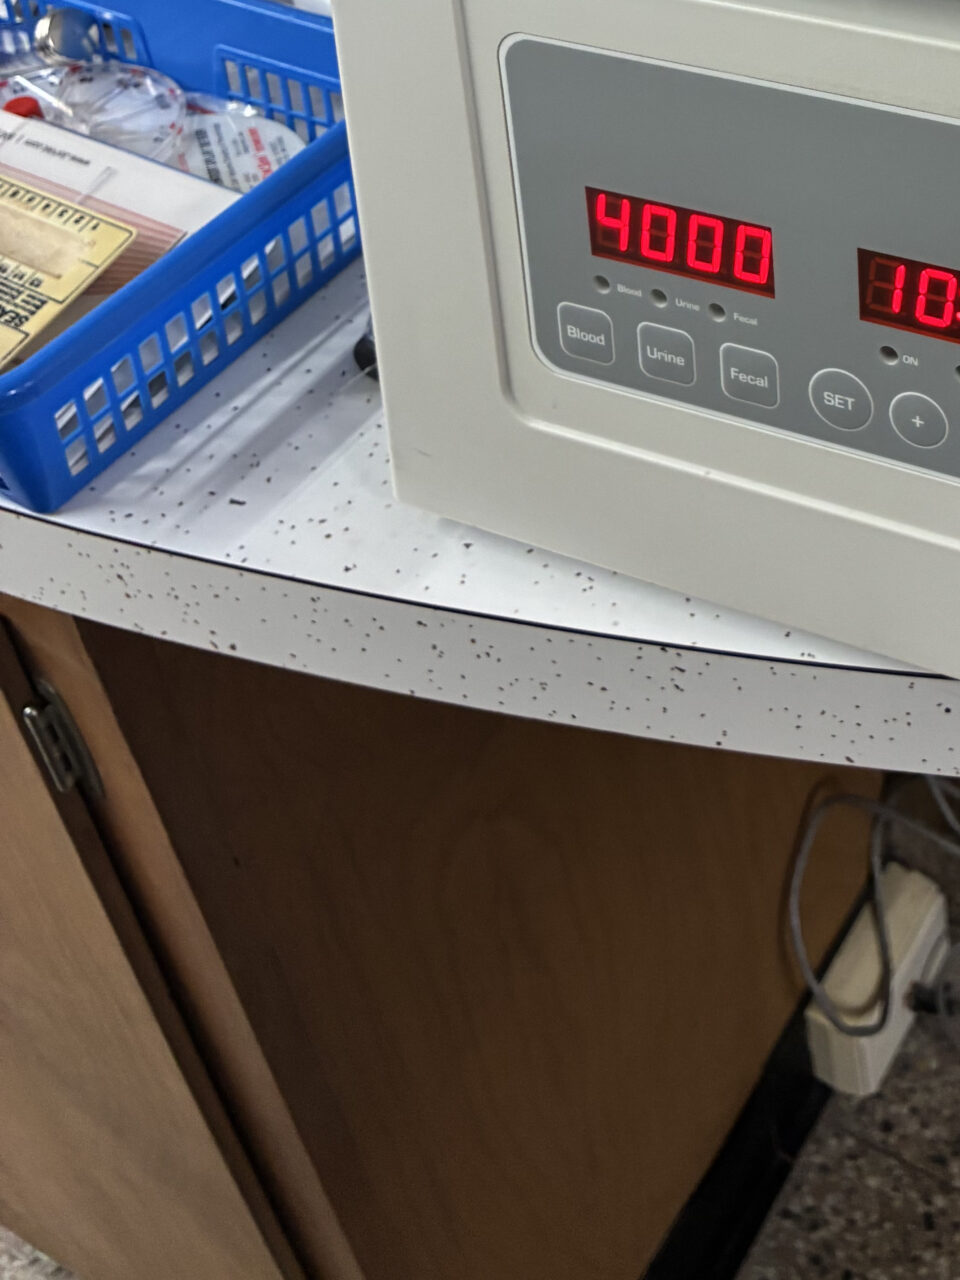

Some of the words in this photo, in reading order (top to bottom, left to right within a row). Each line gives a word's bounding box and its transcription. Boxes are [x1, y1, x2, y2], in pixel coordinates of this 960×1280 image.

[596, 193, 772, 285] 4000
[617, 283, 642, 297] Blood
[675, 298, 700, 311] Urine
[733, 312, 758, 326] Fecal
[567, 324, 605, 346] Blood
[646, 345, 685, 366] Urine
[902, 354, 919, 367] ON
[730, 367, 768, 388] Fecal
[823, 390, 855, 411] SET
